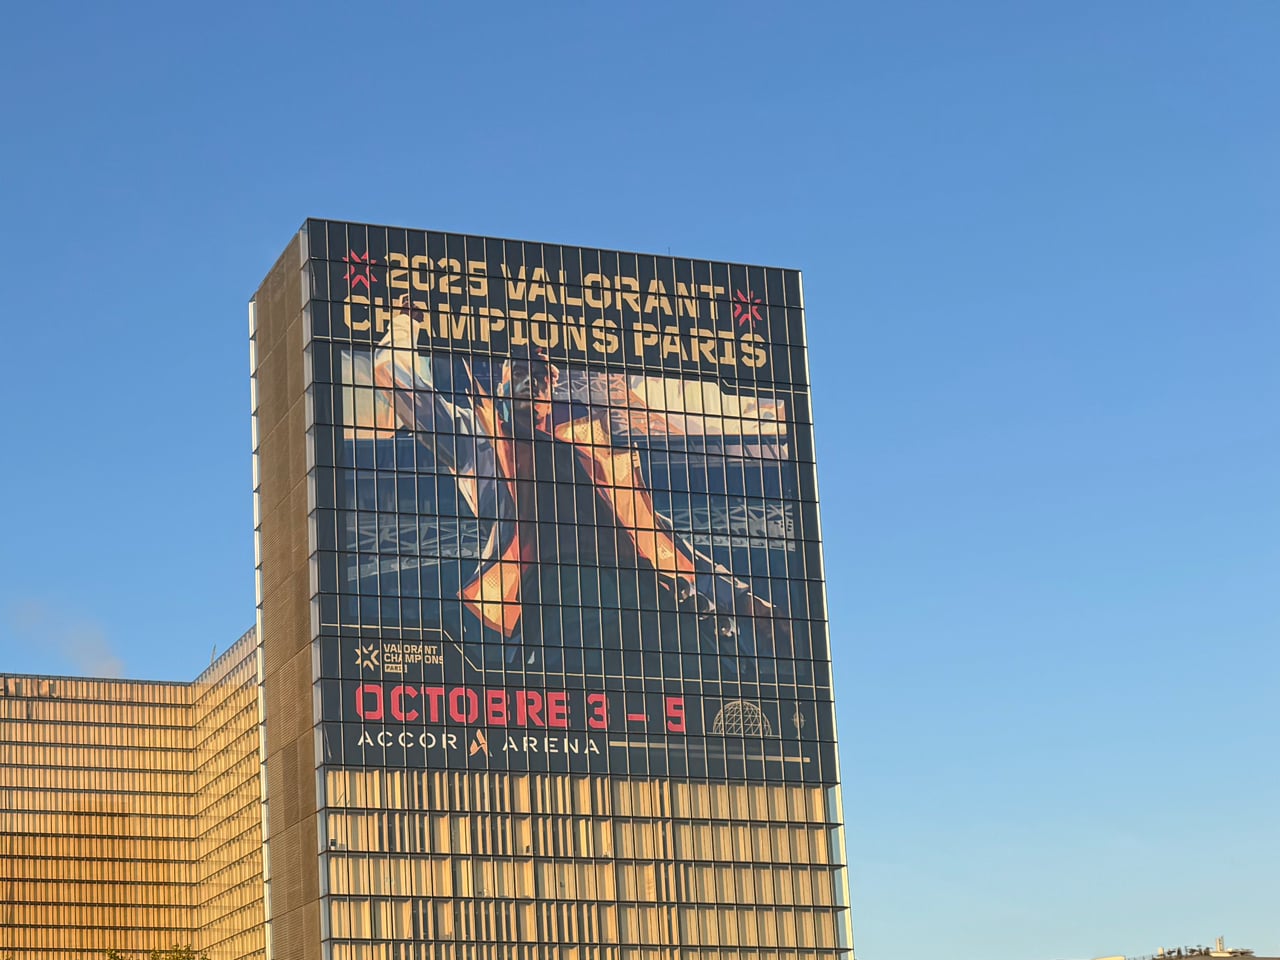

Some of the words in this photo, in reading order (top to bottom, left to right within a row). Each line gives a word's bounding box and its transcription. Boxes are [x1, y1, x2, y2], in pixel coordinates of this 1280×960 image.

[384, 252, 487, 297] 2025
[501, 263, 725, 320] VALORANT
[343, 295, 619, 354] CHAMPIONS
[633, 322, 767, 368] PARIS
[383, 644, 438, 655] VALORANT
[383, 653, 443, 665] CHAMPONS
[355, 684, 571, 728] OCTOBRE
[587, 693, 610, 729] 3
[666, 696, 686, 733] 5
[357, 731, 458, 750] ACCOR
[503, 736, 600, 755] ARENA
